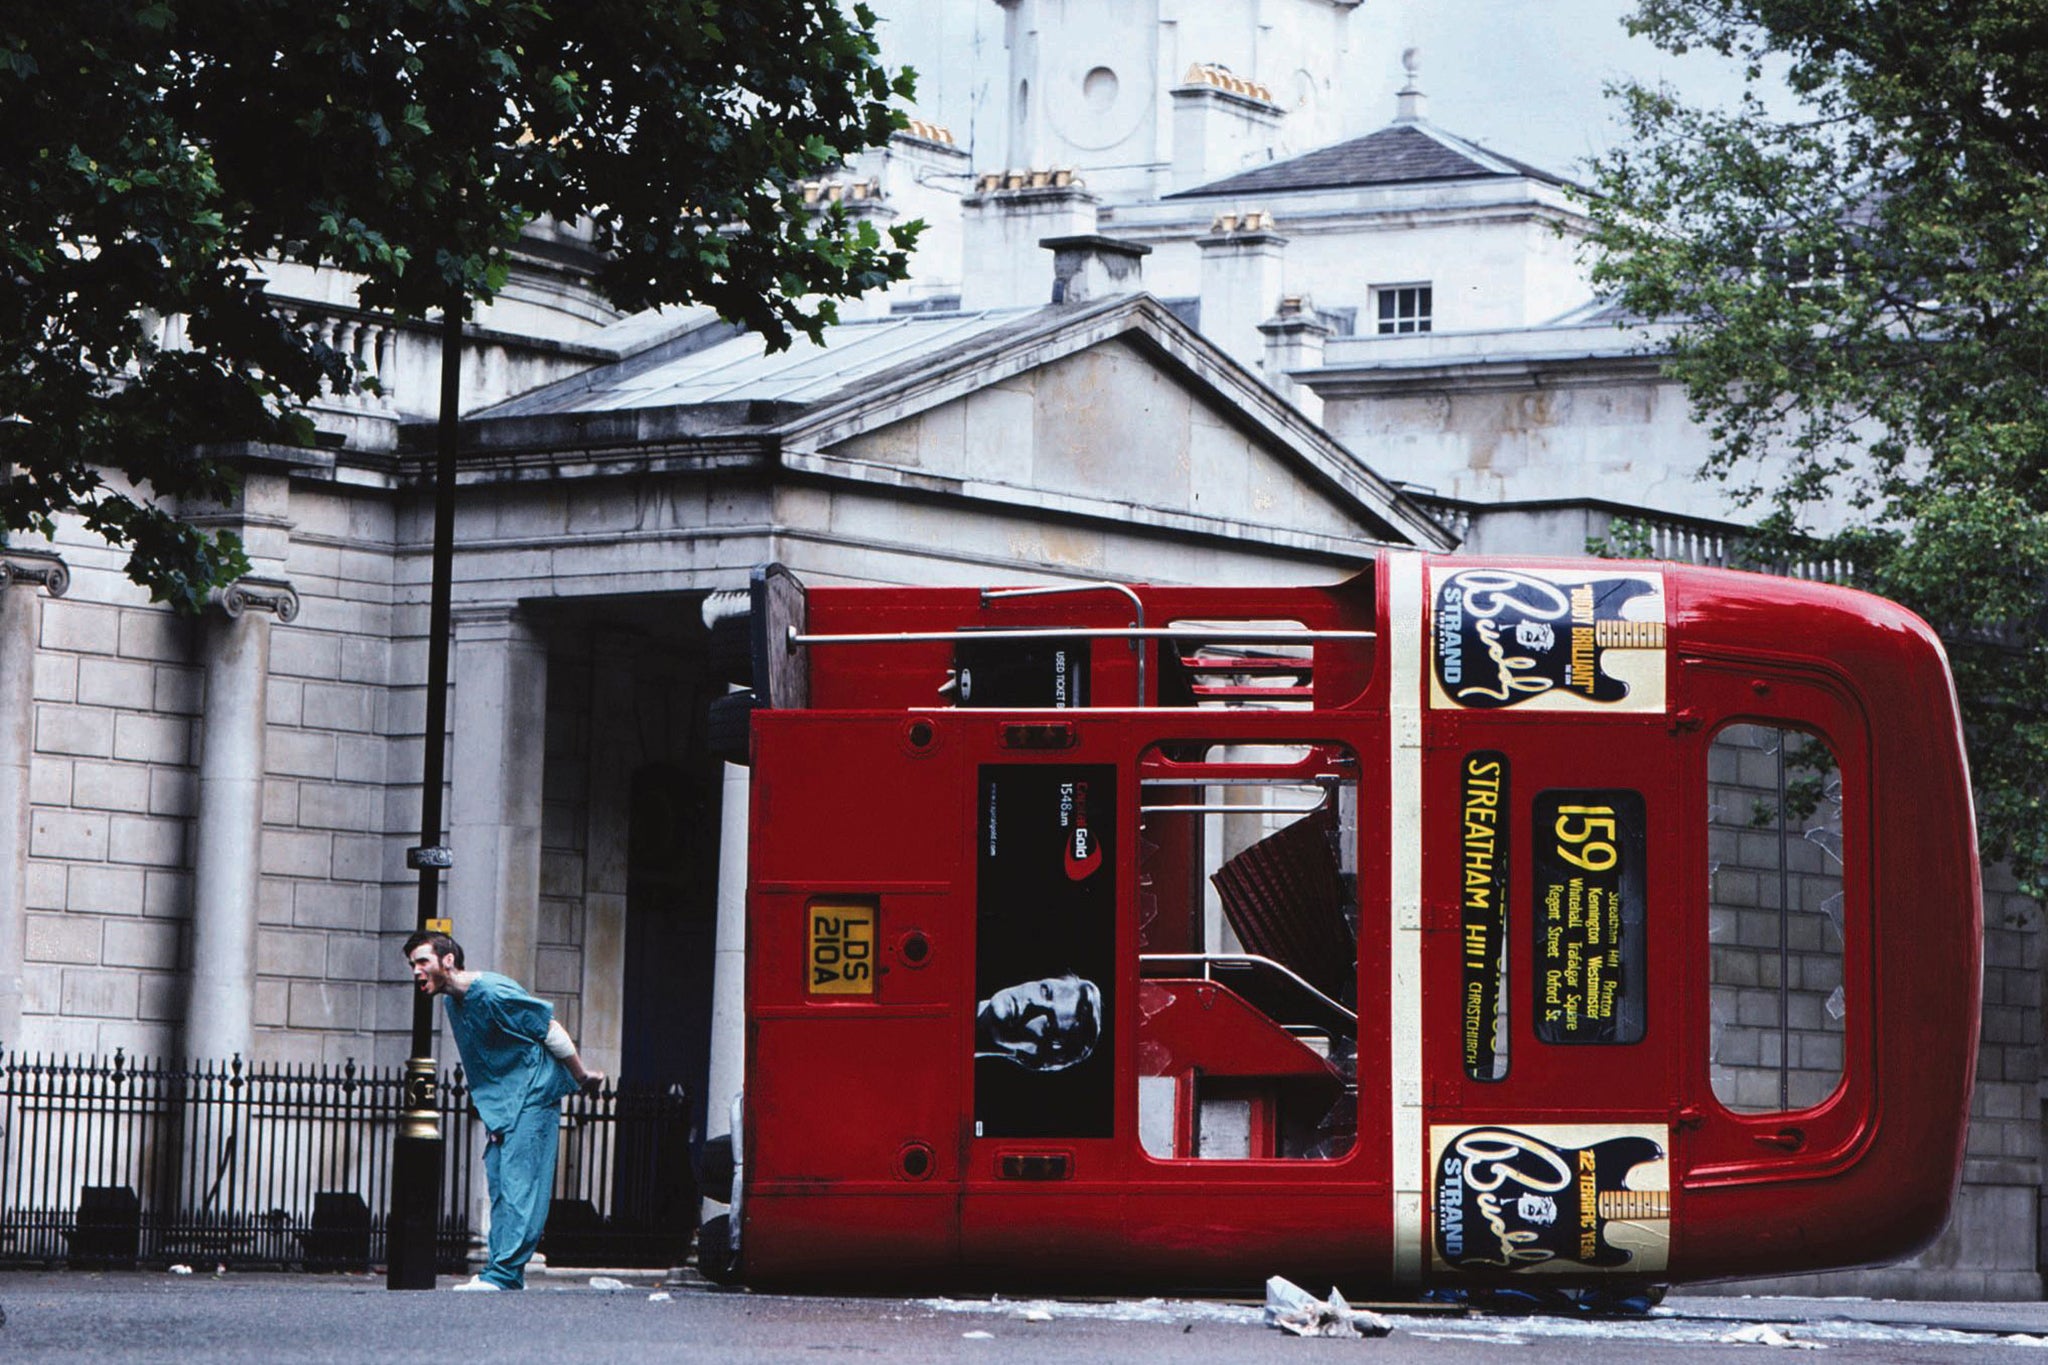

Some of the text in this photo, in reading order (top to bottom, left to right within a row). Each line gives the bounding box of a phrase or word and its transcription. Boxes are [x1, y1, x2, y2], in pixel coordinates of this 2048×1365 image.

[1056, 651, 1065, 673] USED
[1444, 587, 1462, 683] STRAND
[1455, 570, 1569, 700] Buddy
[1056, 675, 1065, 701] TICKET
[1061, 783, 1072, 826] 1548am
[1076, 828, 1087, 858] Gold
[1465, 759, 1500, 908] STREATHAM
[1555, 806, 1618, 872] 159
[814, 916, 840, 985] 210A
[843, 919, 869, 981] LDS
[1545, 885, 1563, 1021] Regent Street Oxford St
[1565, 878, 1582, 1030] Whitehall Trafalgar Square
[1586, 888, 1603, 1019] Kennington Westminster
[1600, 981, 1616, 1017] Brixton
[1444, 1158, 1463, 1255] STRAND
[1455, 1131, 1572, 1266] Buddy
